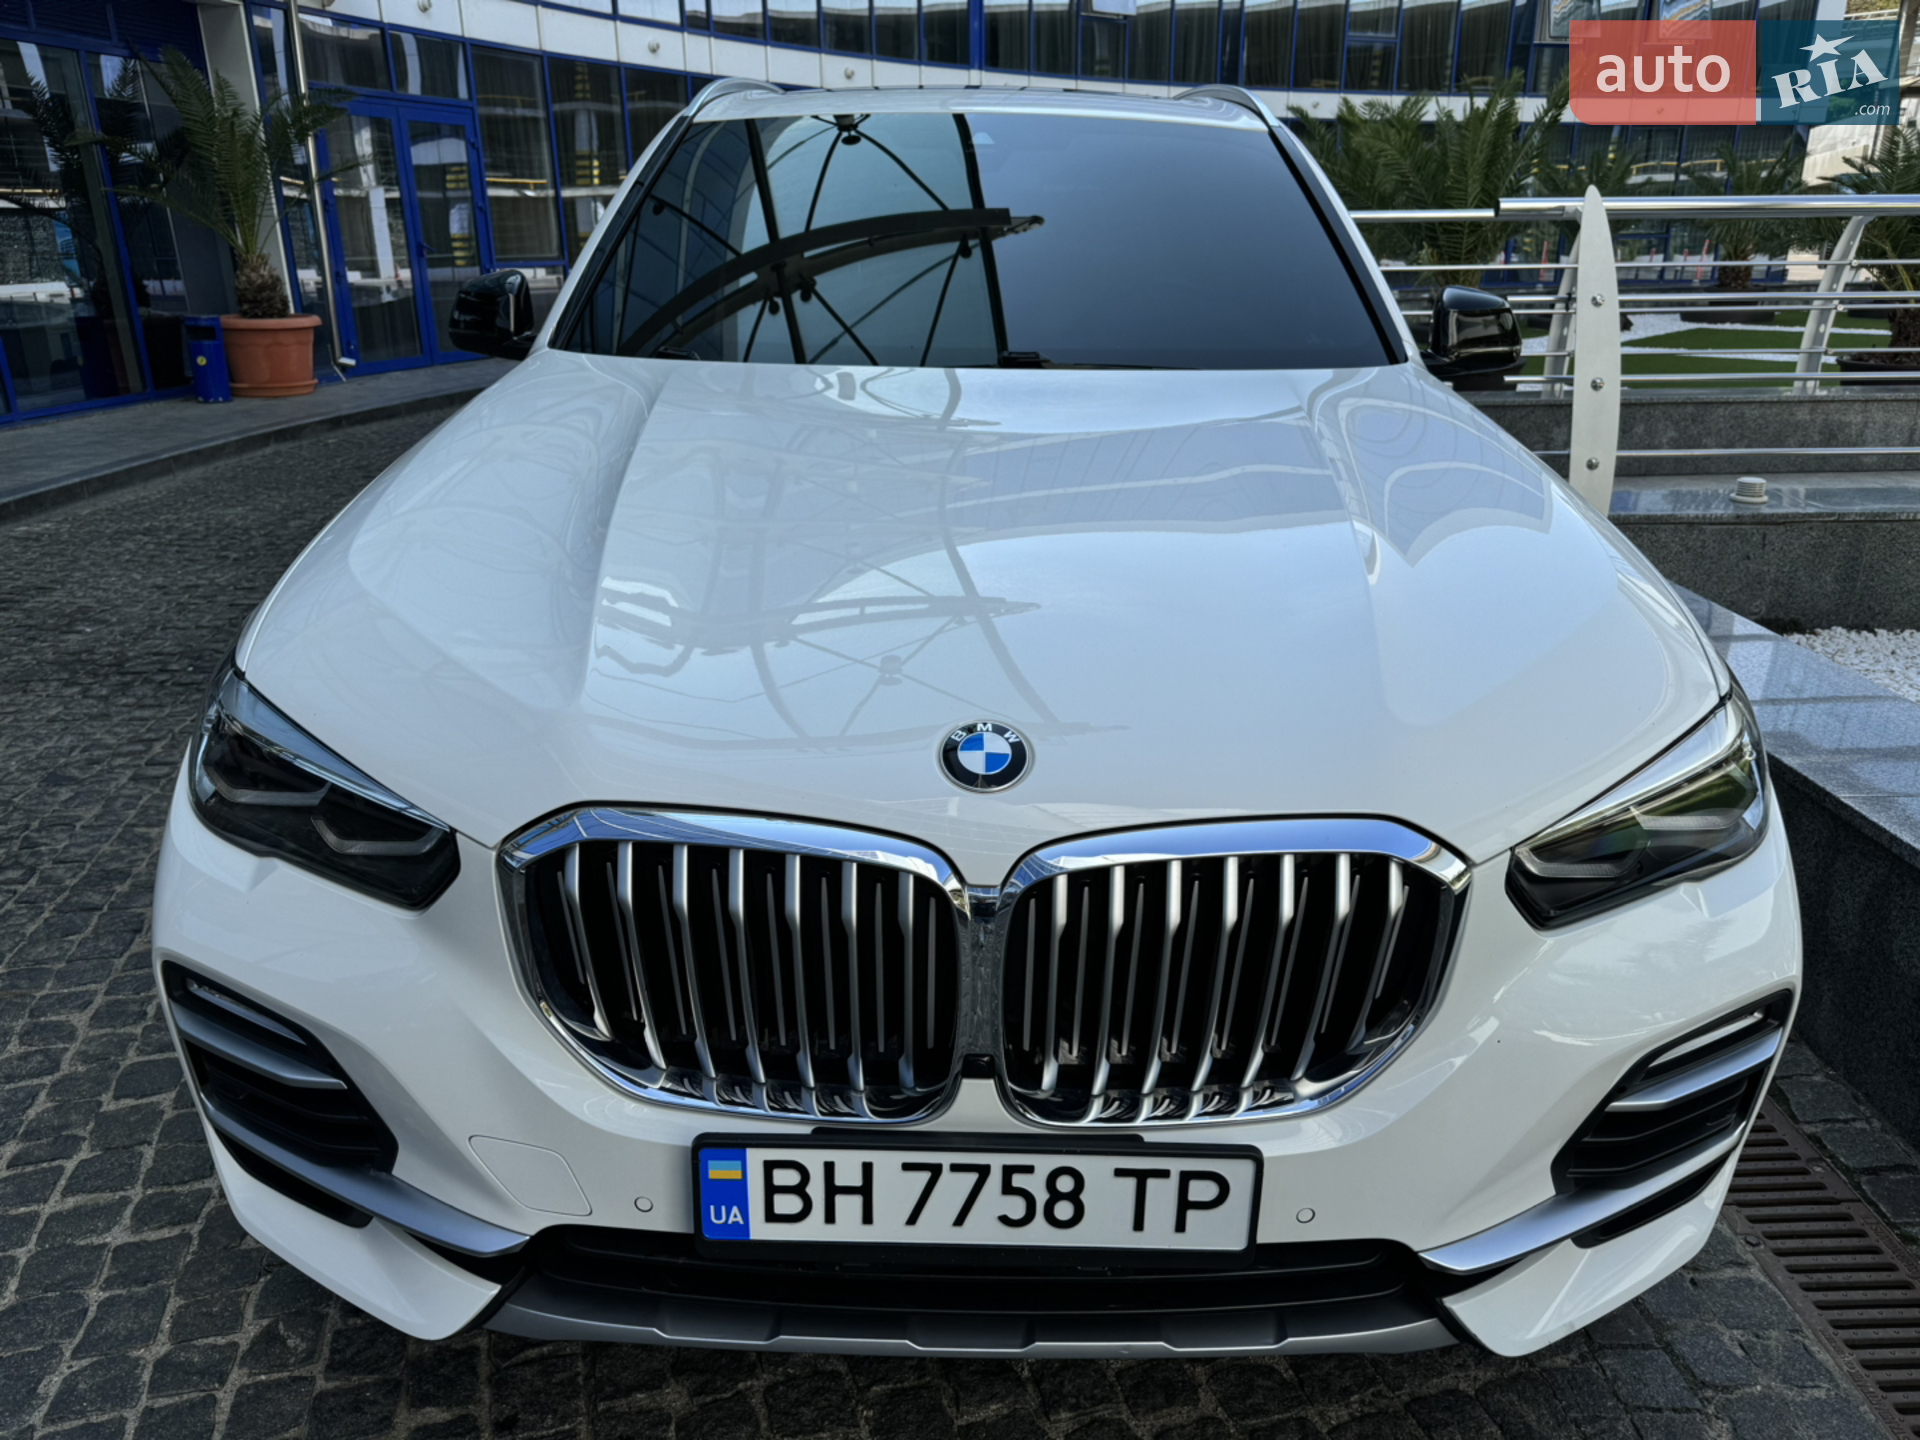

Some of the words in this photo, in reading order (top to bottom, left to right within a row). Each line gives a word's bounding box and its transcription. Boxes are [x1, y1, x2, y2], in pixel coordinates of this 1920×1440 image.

[950, 723, 1021, 743] BMW
[762, 1159, 874, 1225] BH
[901, 1162, 1085, 1229] 7758
[1113, 1167, 1230, 1233] TP
[709, 1205, 744, 1225] UA
